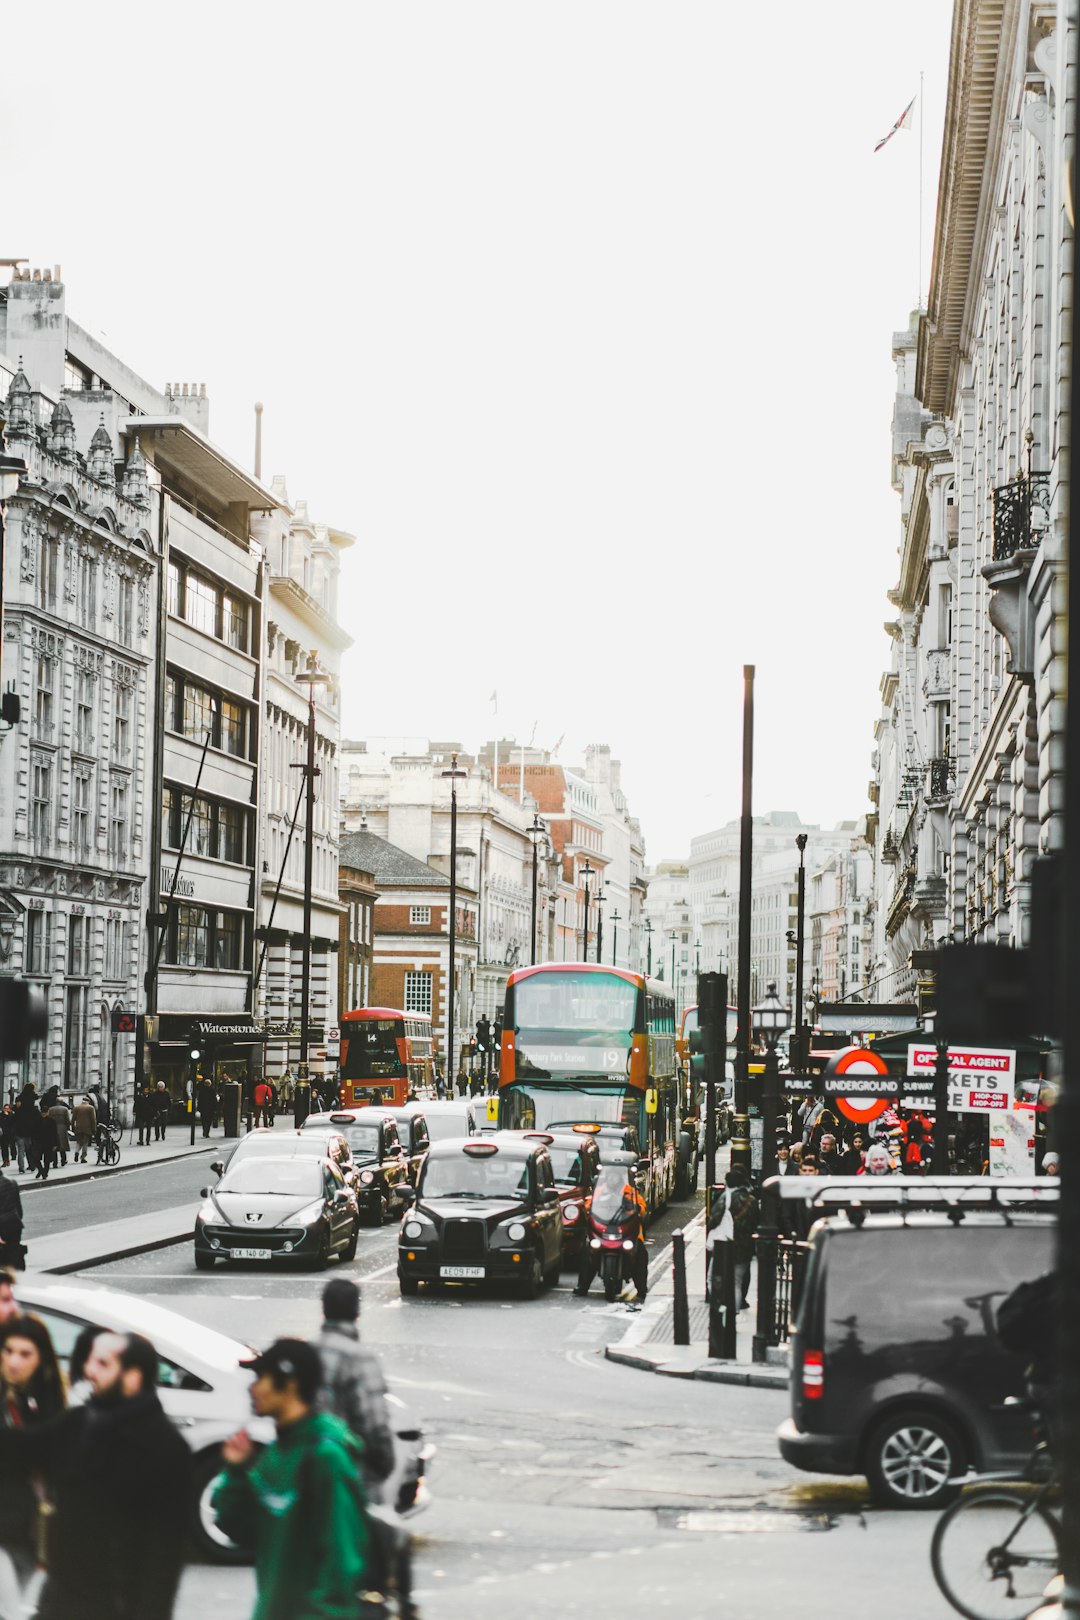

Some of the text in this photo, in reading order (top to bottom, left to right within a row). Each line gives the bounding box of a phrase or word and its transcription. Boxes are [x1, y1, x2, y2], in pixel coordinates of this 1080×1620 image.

[199, 1022, 262, 1034] Waterstones
[367, 1034, 377, 1043] 14
[550, 1051, 563, 1063] Park
[564, 1051, 586, 1063] Station
[602, 1050, 618, 1068] 19
[968, 1057, 1007, 1068] AGENT
[784, 1080, 813, 1090] PUBLIC
[825, 1080, 898, 1092] UNDERGROUND
[903, 1082, 934, 1091] SUBWAY
